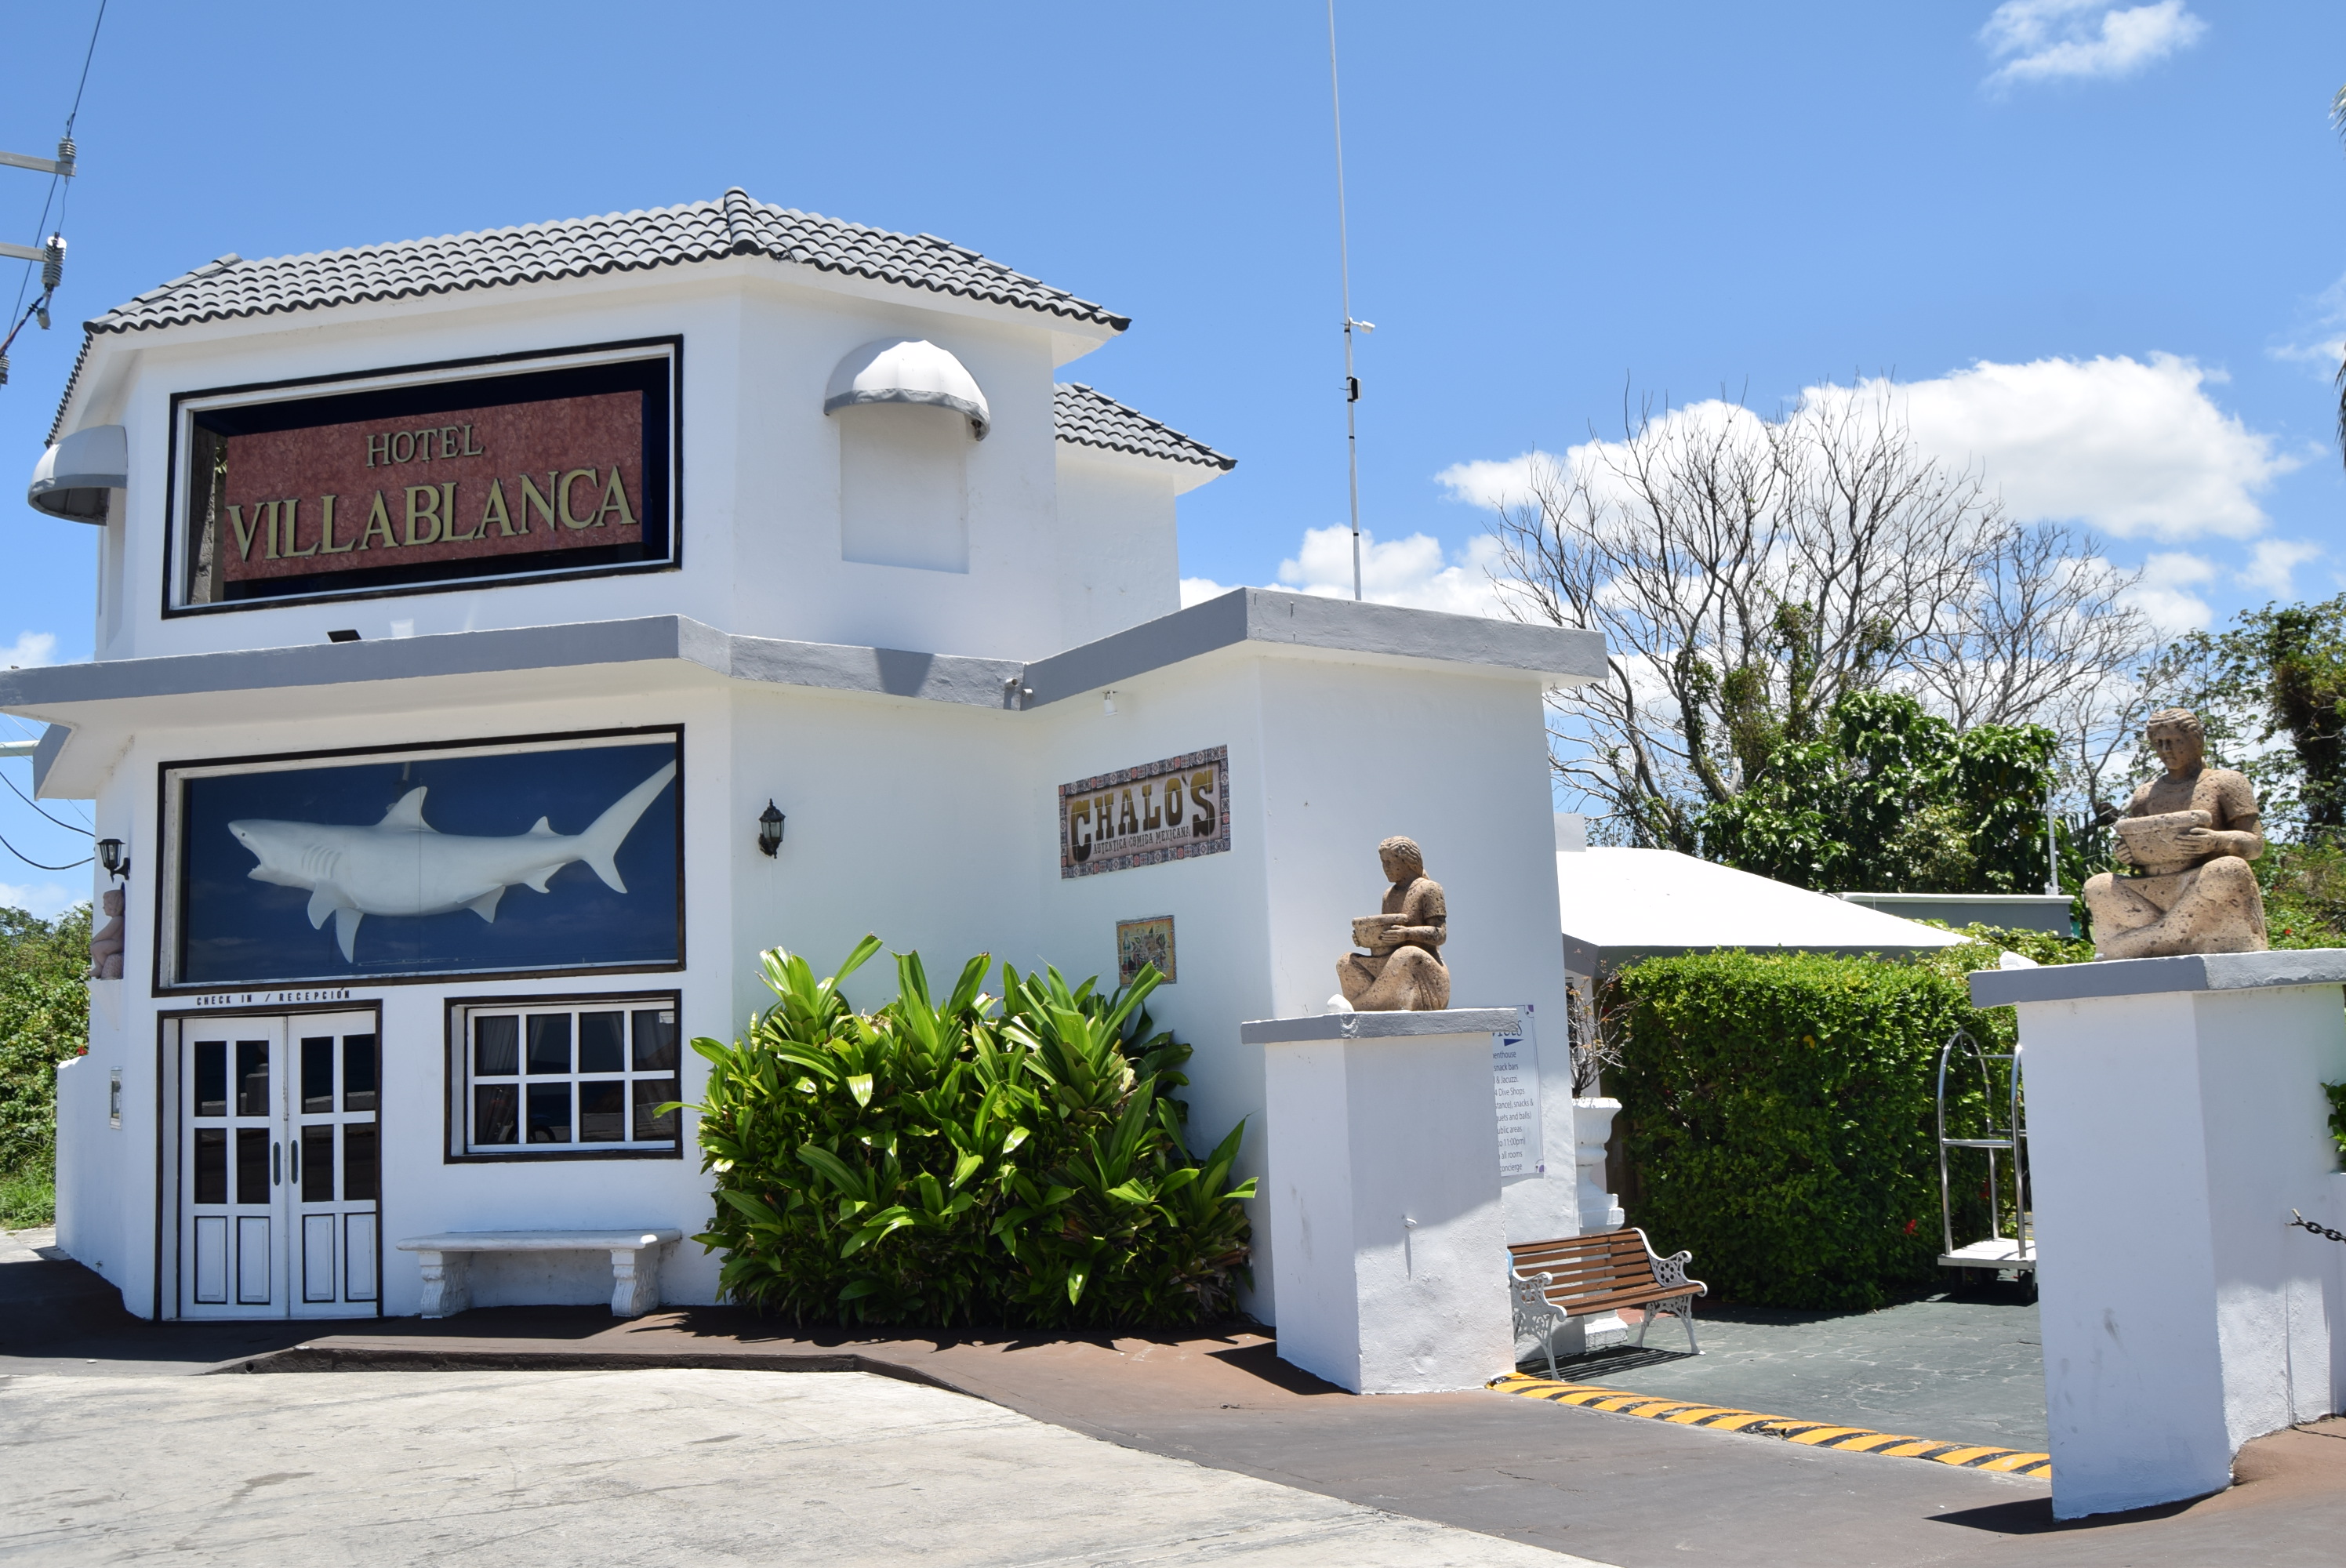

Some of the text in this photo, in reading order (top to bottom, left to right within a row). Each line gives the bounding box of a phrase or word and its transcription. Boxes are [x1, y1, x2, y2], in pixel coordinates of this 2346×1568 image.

[365, 424, 485, 468] HOTEL
[227, 465, 637, 563] VILLABLANCA
[1093, 826, 1191, 855] AUTENTICA COMIDA MEXICANA
[197, 994, 231, 1006] CHECK
[242, 993, 252, 1003] IN
[279, 986, 350, 1002] RECEPCIÓN
[1494, 1062, 1519, 1072] snack bars
[1498, 1087, 1509, 1096] Dive
[1510, 1087, 1525, 1096] Shops
[1513, 1098, 1529, 1108] snacks
[1519, 1111, 1532, 1120] balls)
[1503, 1137, 1526, 1147] 11:00pm)
